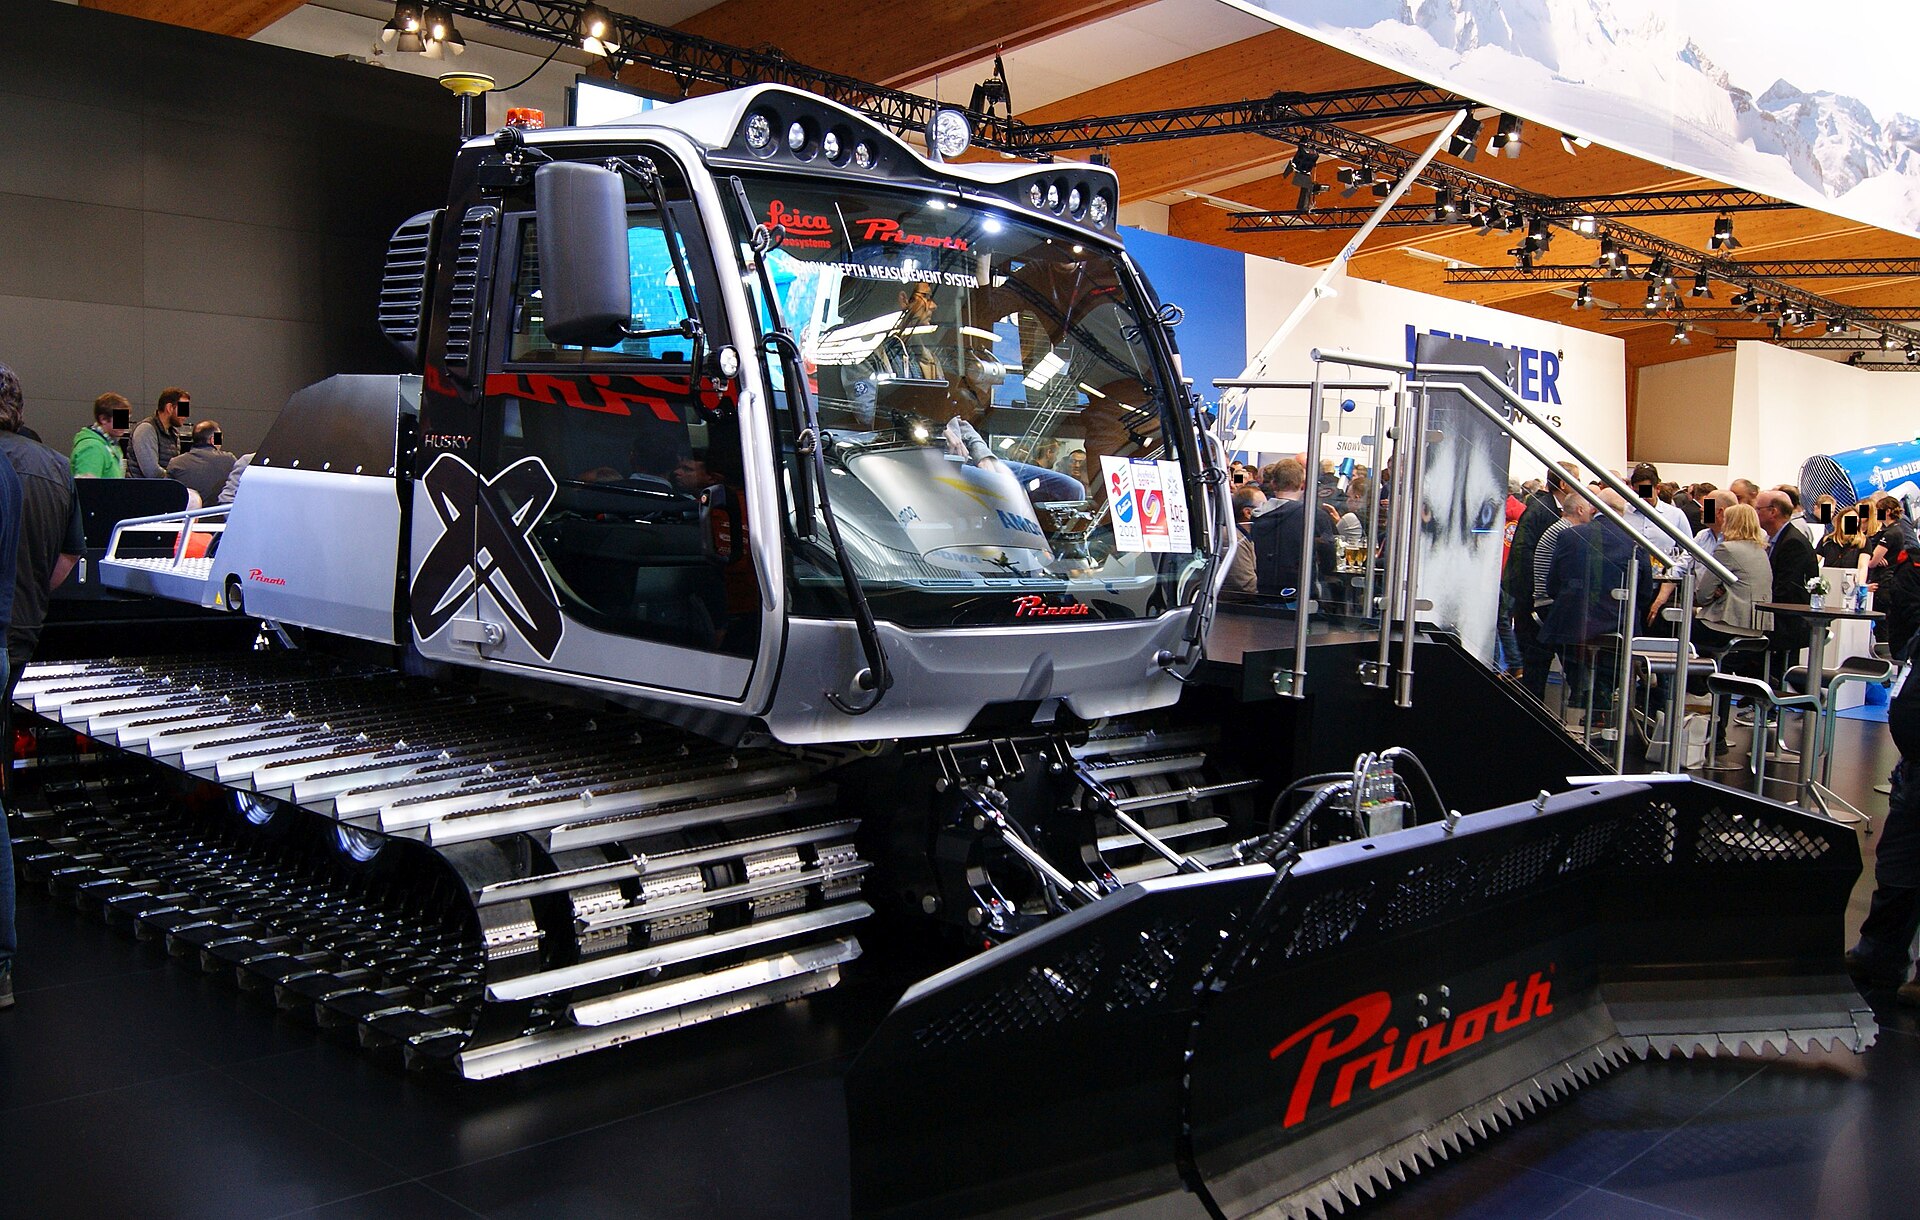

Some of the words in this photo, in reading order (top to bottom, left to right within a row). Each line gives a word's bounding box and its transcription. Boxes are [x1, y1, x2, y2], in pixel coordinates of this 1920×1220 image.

[763, 199, 832, 231] Leica
[856, 218, 968, 251] Prinoth
[831, 262, 867, 277] DEPTH
[869, 265, 942, 284] MEASUREMENT
[944, 273, 980, 289] SYSTEM
[424, 434, 472, 449] HUSKY
[248, 568, 286, 586] Prinoth
[1012, 594, 1089, 617] Prinoth
[1269, 971, 1553, 1129] Prinoth
